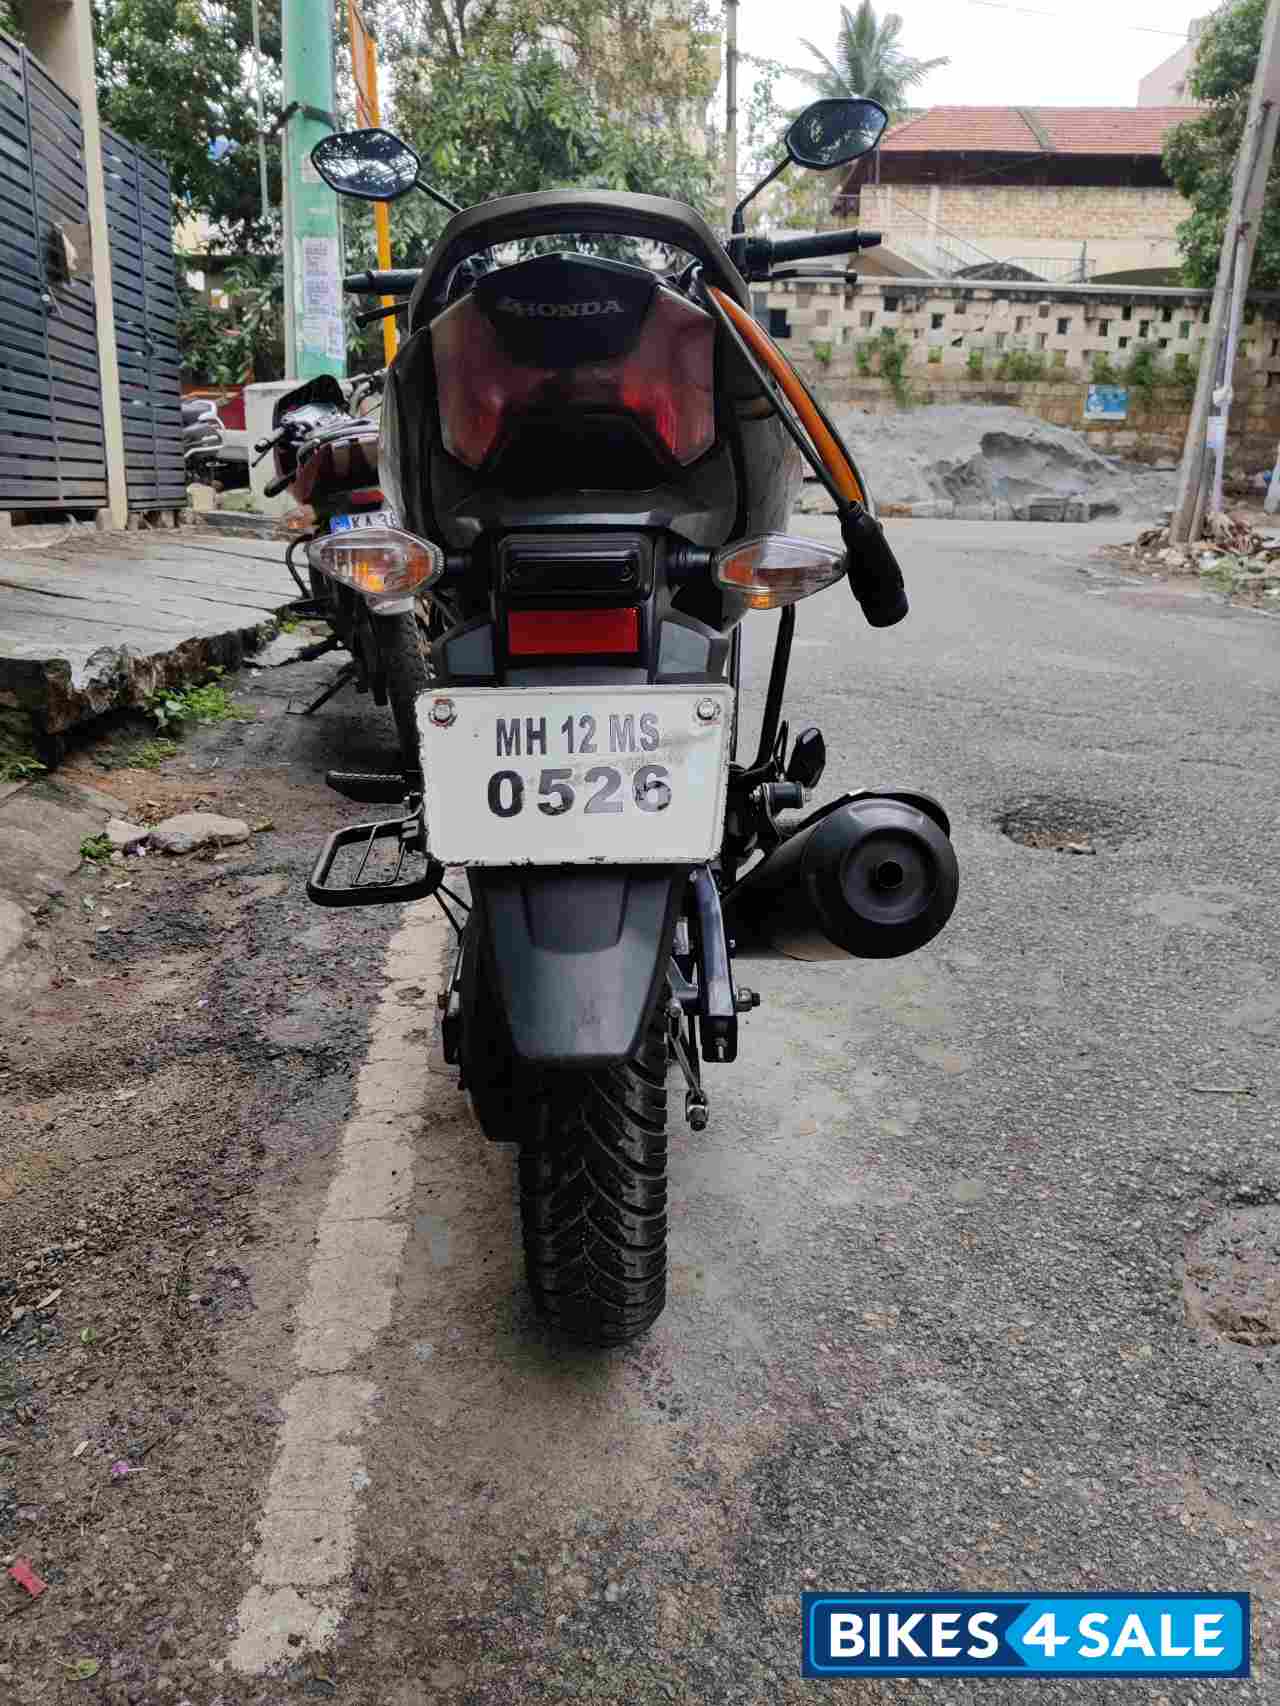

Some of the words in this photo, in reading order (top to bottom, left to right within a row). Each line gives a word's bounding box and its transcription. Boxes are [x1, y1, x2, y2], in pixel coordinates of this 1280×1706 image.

[514, 299, 625, 318] HONDA
[352, 514, 374, 528] KA
[496, 717, 547, 757] MH
[561, 714, 599, 754] 12
[608, 711, 661, 753] MS
[487, 764, 673, 818] 0526
